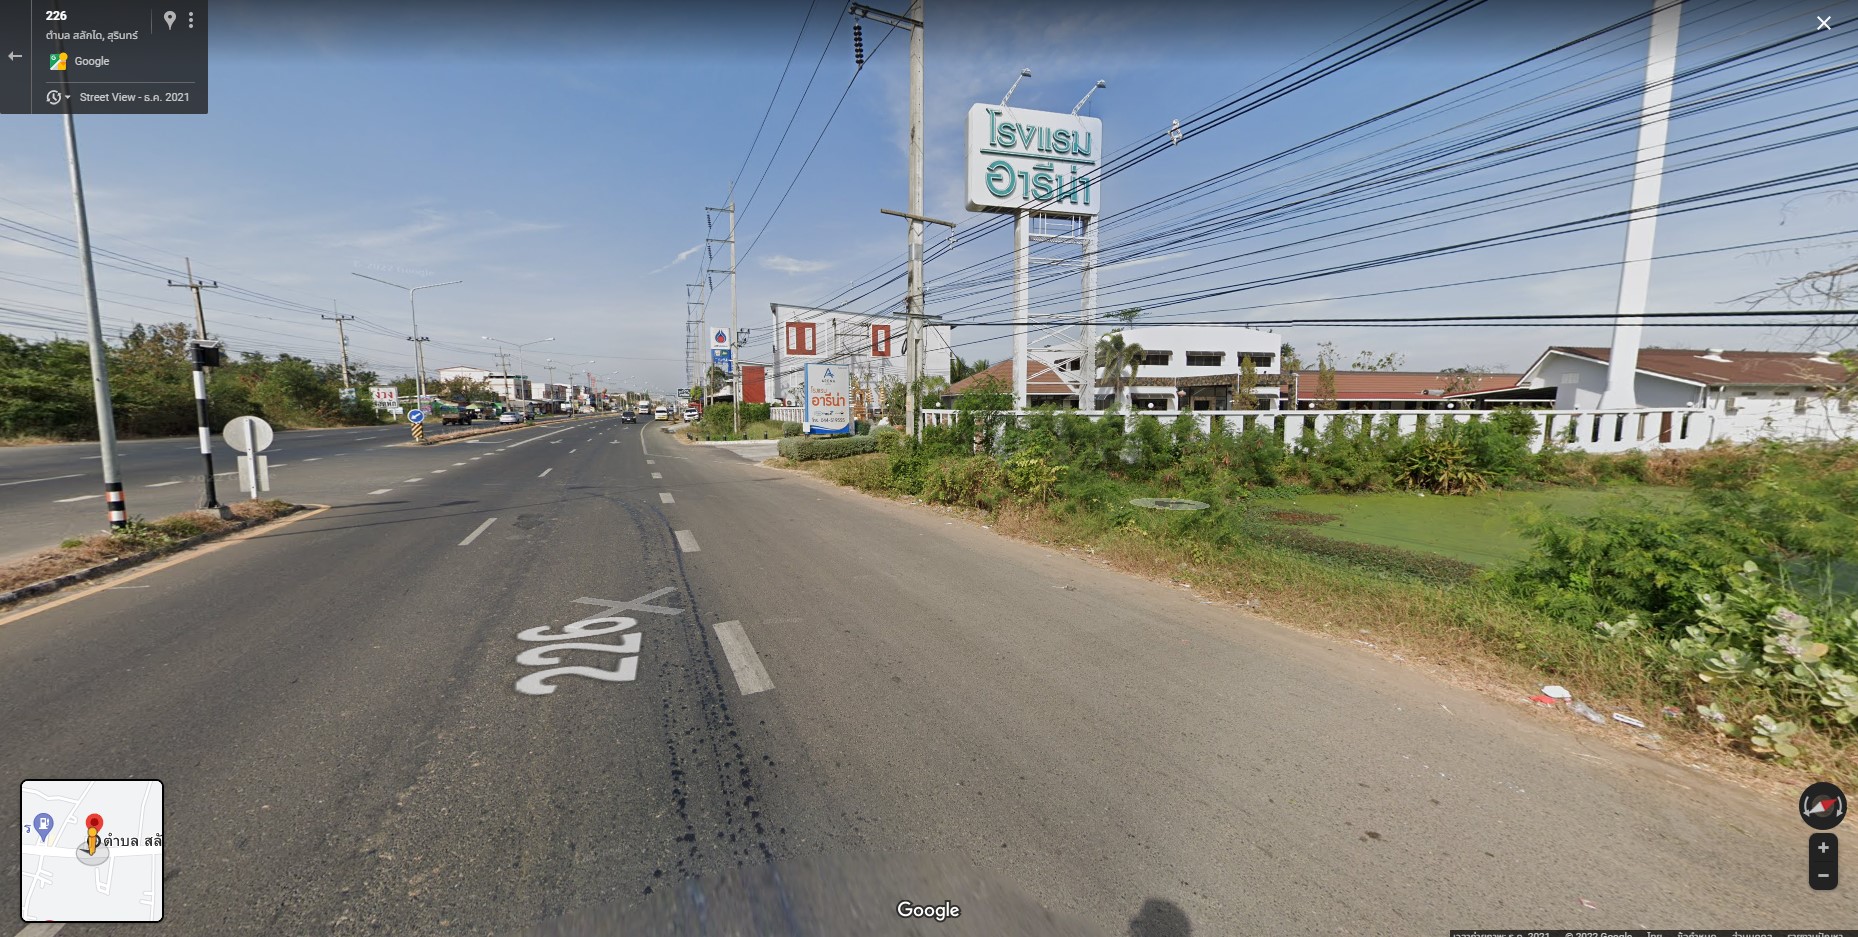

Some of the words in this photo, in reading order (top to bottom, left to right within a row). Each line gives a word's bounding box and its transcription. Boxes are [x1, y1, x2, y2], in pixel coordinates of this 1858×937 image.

[986, 108, 1092, 156] โรงแรม
[985, 160, 1091, 205] อารีน่า
[812, 392, 845, 406] อารีน่า
